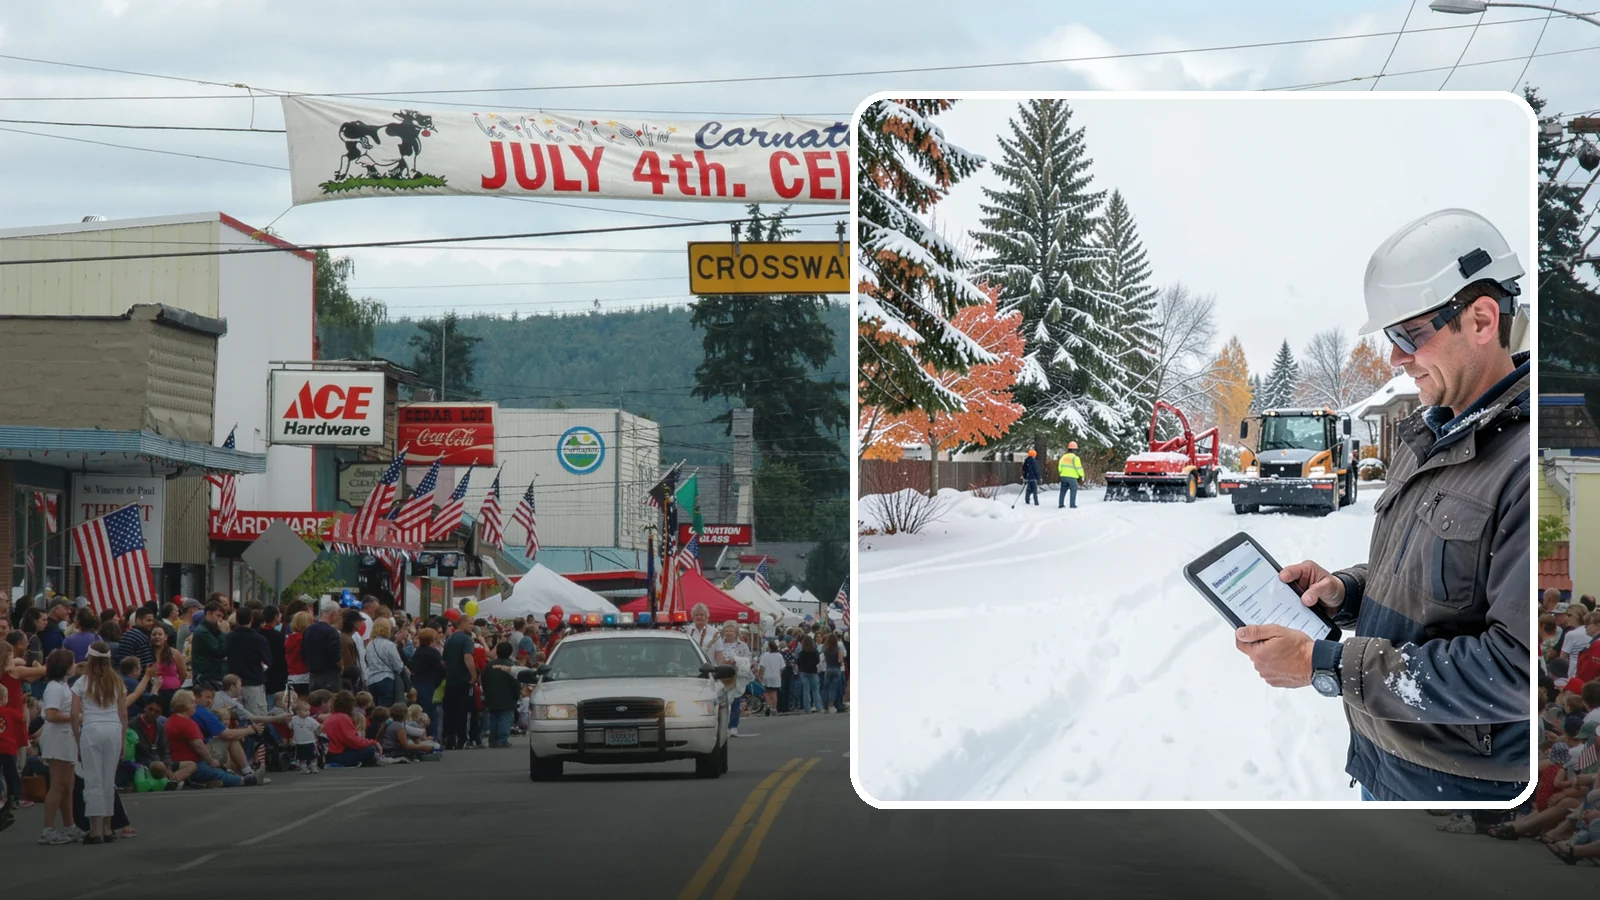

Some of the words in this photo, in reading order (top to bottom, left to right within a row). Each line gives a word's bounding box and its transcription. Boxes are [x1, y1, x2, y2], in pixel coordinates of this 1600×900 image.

[695, 121, 850, 150] Carnat
[481, 141, 605, 193] JULY
[632, 150, 746, 198] 4th.
[697, 254, 850, 280] CROSSWA
[282, 380, 373, 420] ACE
[405, 409, 453, 422] CEDAR
[284, 421, 370, 436] Hardware
[416, 428, 477, 447] Coca-Cola
[353, 467, 385, 481] Simpl
[96, 484, 124, 495] Vincent
[126, 485, 136, 495] de
[138, 485, 155, 495] Paul
[212, 516, 331, 535] HARDARE
[688, 526, 742, 535] CRNATION
[699, 535, 730, 543] GLASS
